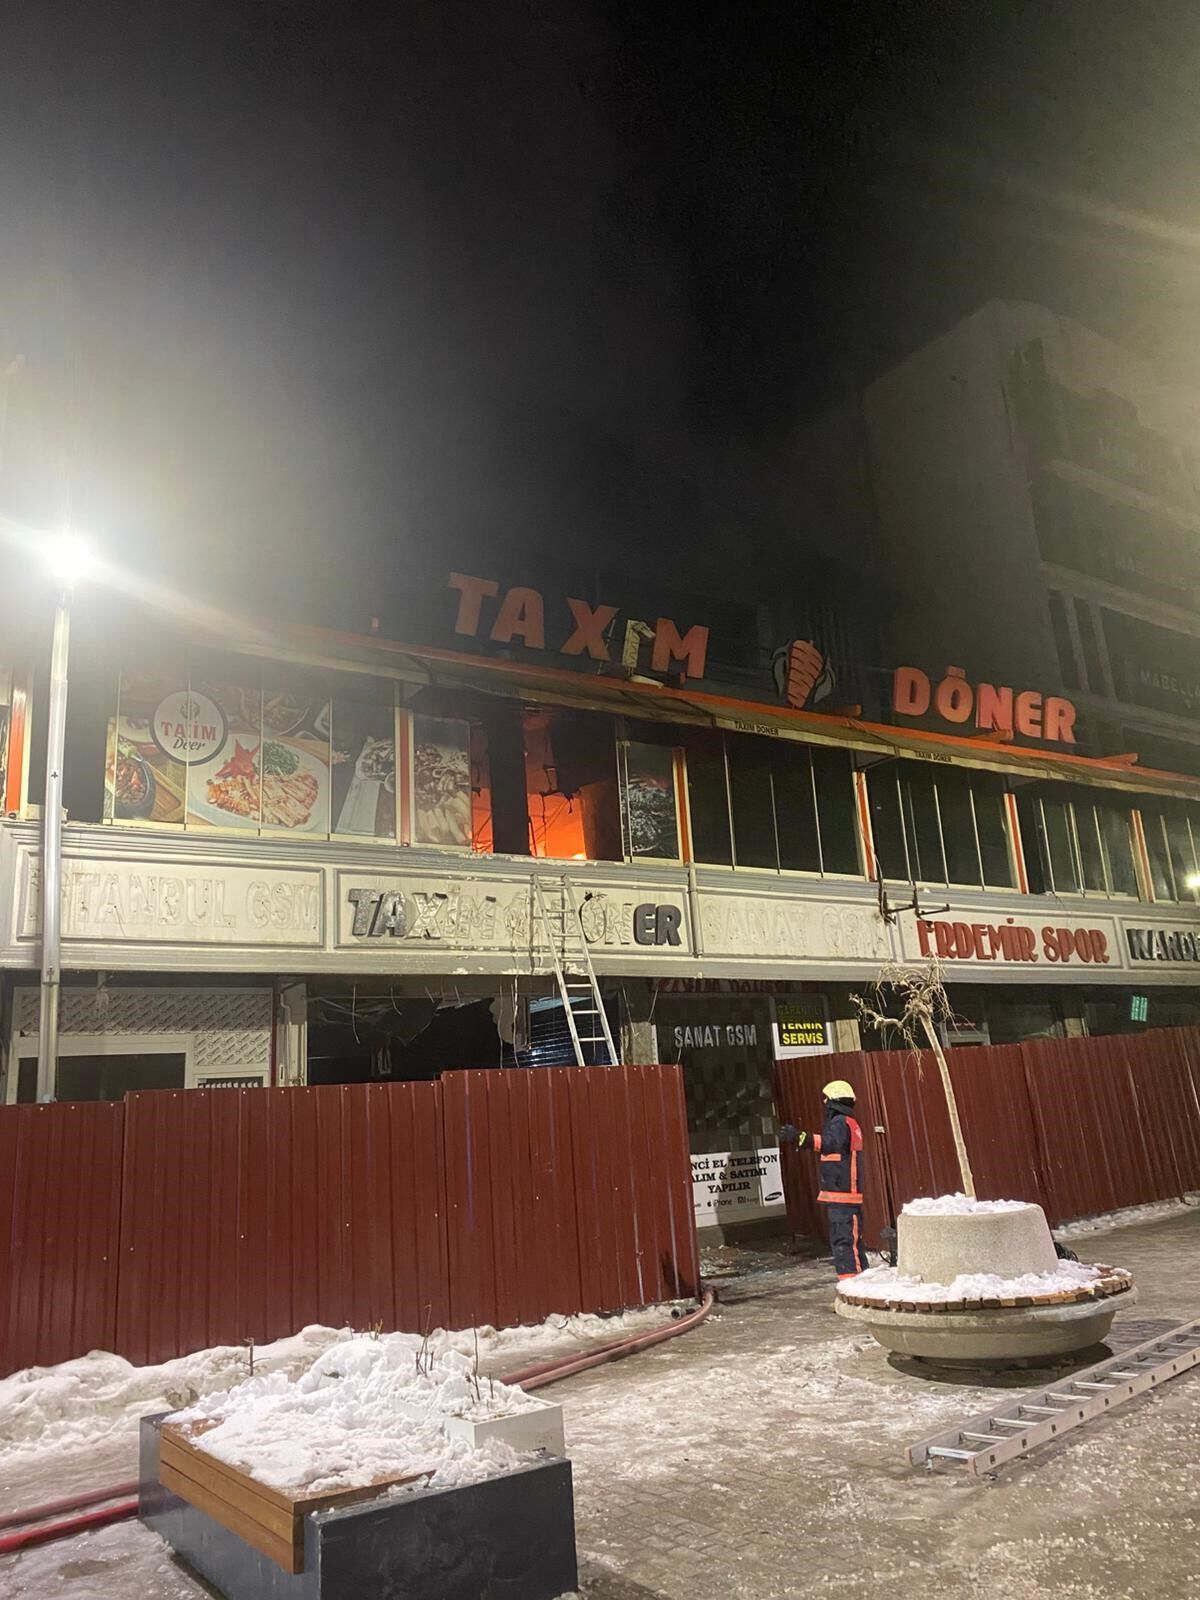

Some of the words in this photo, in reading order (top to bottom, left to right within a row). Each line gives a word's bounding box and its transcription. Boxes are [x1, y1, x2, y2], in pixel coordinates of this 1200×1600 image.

[893, 665, 1077, 744] DÖNER
[1043, 927, 1110, 964] SPOR
[674, 1025, 721, 1049] SANAT
[726, 1024, 757, 1047] GSM
[713, 1159, 727, 1168] EL
[728, 1154, 777, 1167] TELEFON
[719, 1172, 727, 1180] &
[707, 1181, 751, 1194] YAPILIR
